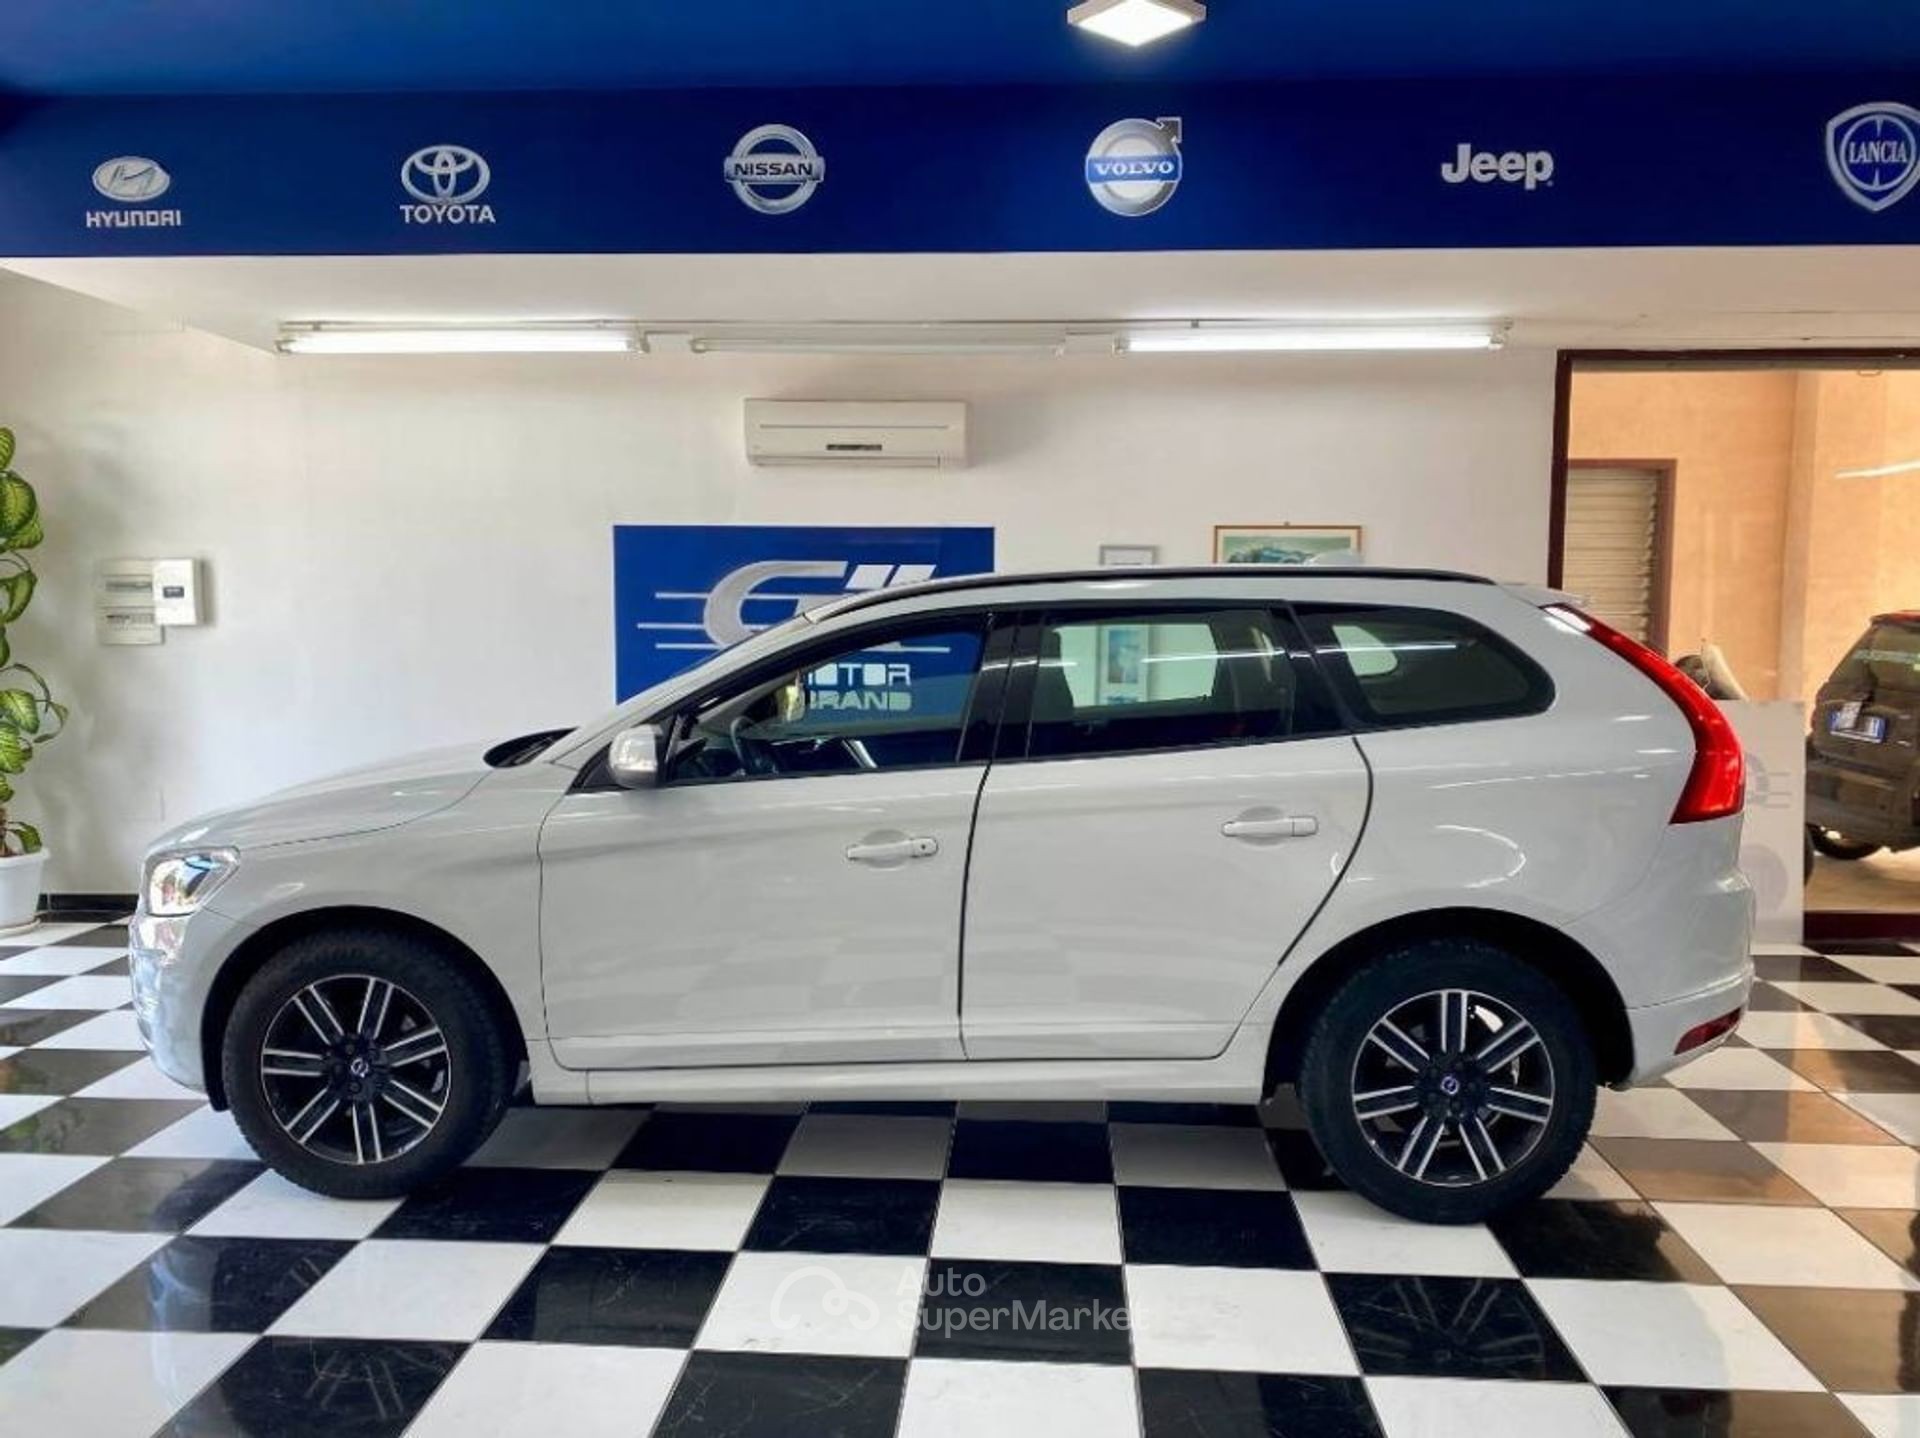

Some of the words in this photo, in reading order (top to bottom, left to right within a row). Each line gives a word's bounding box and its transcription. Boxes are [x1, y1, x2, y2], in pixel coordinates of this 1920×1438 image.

[1849, 140, 1908, 164] LANCIA
[733, 162, 814, 177] NISSAN
[1093, 160, 1175, 177] VOLVO
[1440, 143, 1555, 190] Jeep
[86, 210, 182, 228] HYUNDAI
[400, 205, 496, 224] TOYOTA
[807, 662, 912, 687] OTOR
